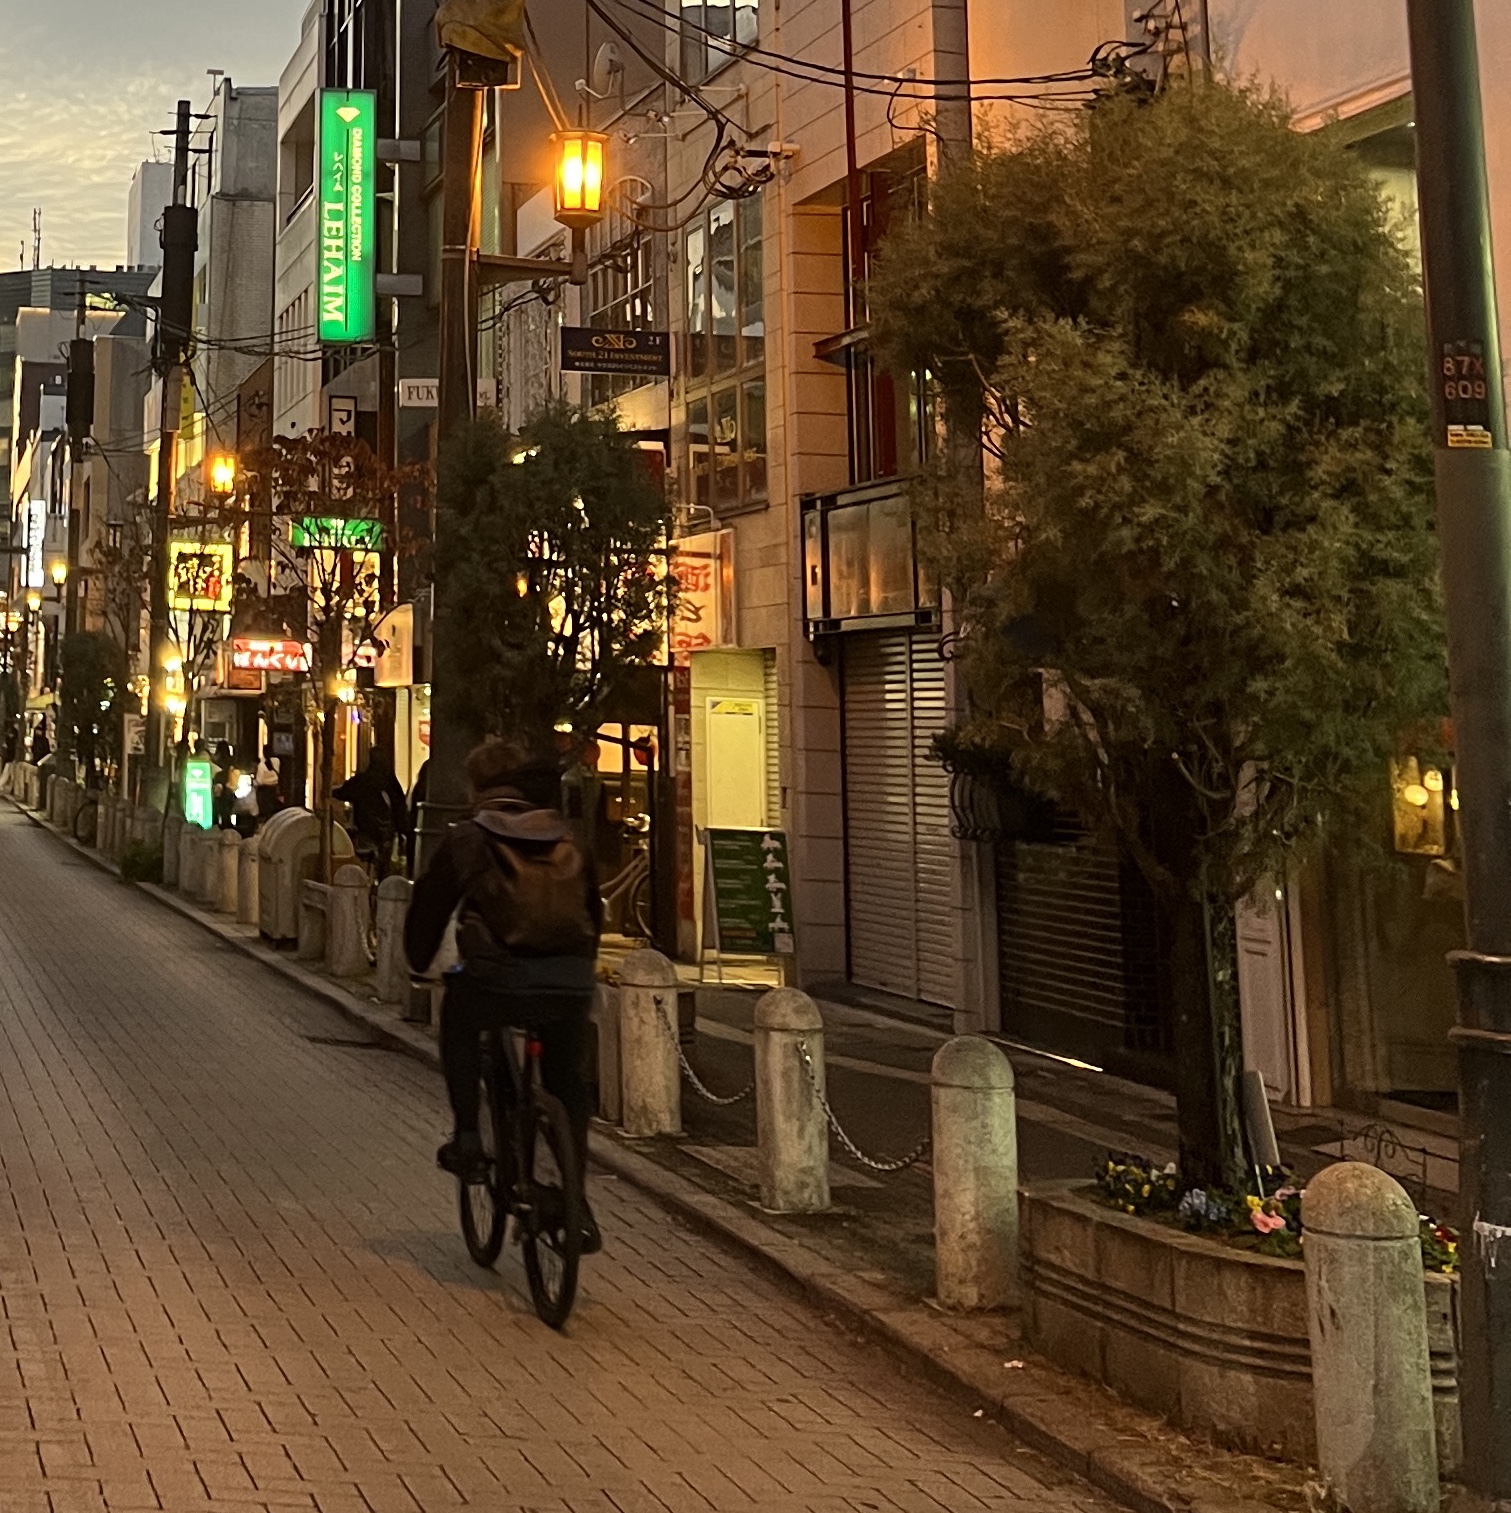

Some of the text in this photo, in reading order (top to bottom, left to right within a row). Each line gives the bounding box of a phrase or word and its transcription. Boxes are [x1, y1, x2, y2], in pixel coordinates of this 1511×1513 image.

[351, 127, 363, 262] DIAMOND COLLECTION
[321, 201, 345, 323] LEHAIM
